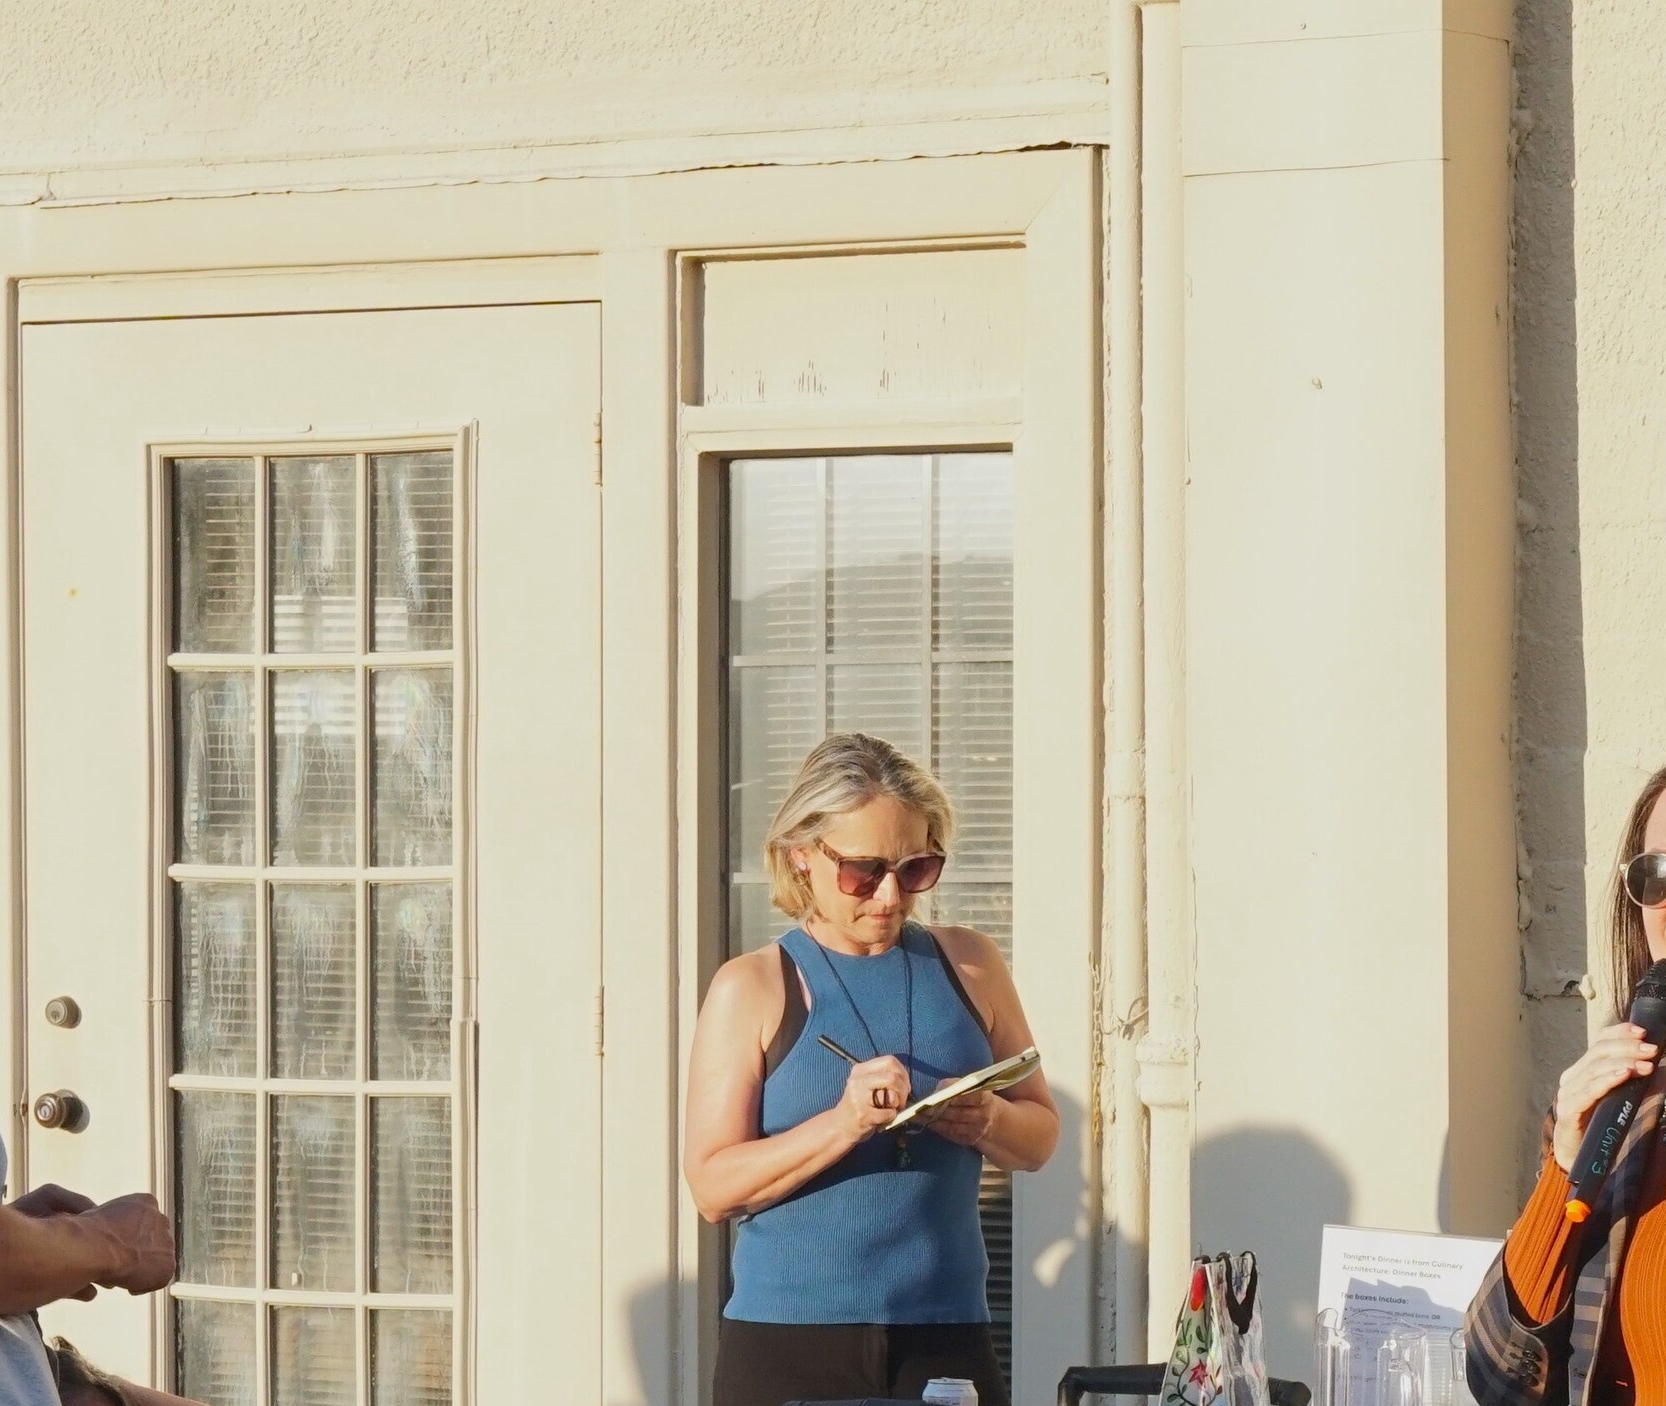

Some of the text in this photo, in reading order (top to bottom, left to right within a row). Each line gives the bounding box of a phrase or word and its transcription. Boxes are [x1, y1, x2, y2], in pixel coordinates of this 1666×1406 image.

[1617, 1100, 1633, 1127] PYLE
[1600, 1127, 1621, 1156] Unit
[1342, 1252, 1376, 1263] Tonight's
[1377, 1255, 1402, 1265] Dinner
[1412, 1258, 1430, 1267] from
[1431, 1260, 1464, 1271] Culinary
[1342, 1264, 1441, 1279] Architecture: Dinner Boxes
[1355, 1293, 1377, 1302] boxes
